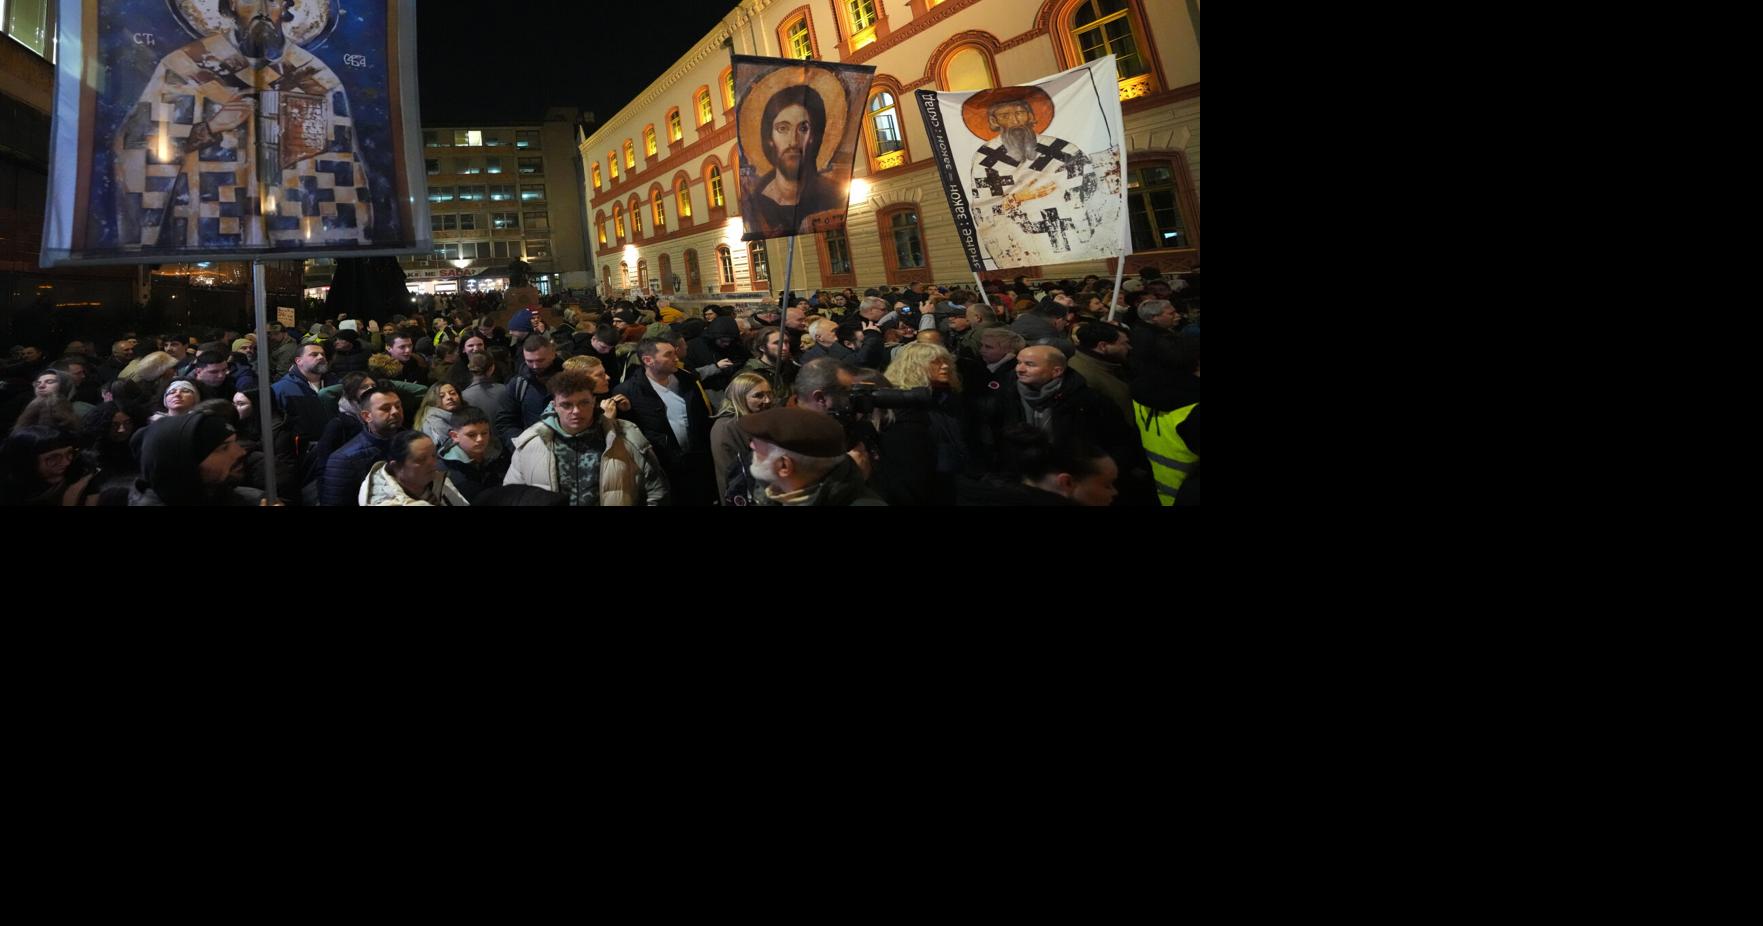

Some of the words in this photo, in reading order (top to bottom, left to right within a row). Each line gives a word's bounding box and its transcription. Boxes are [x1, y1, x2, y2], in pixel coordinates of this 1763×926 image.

[922, 93, 940, 127] склад
[937, 135, 952, 170] закон
[950, 184, 967, 220] закон
